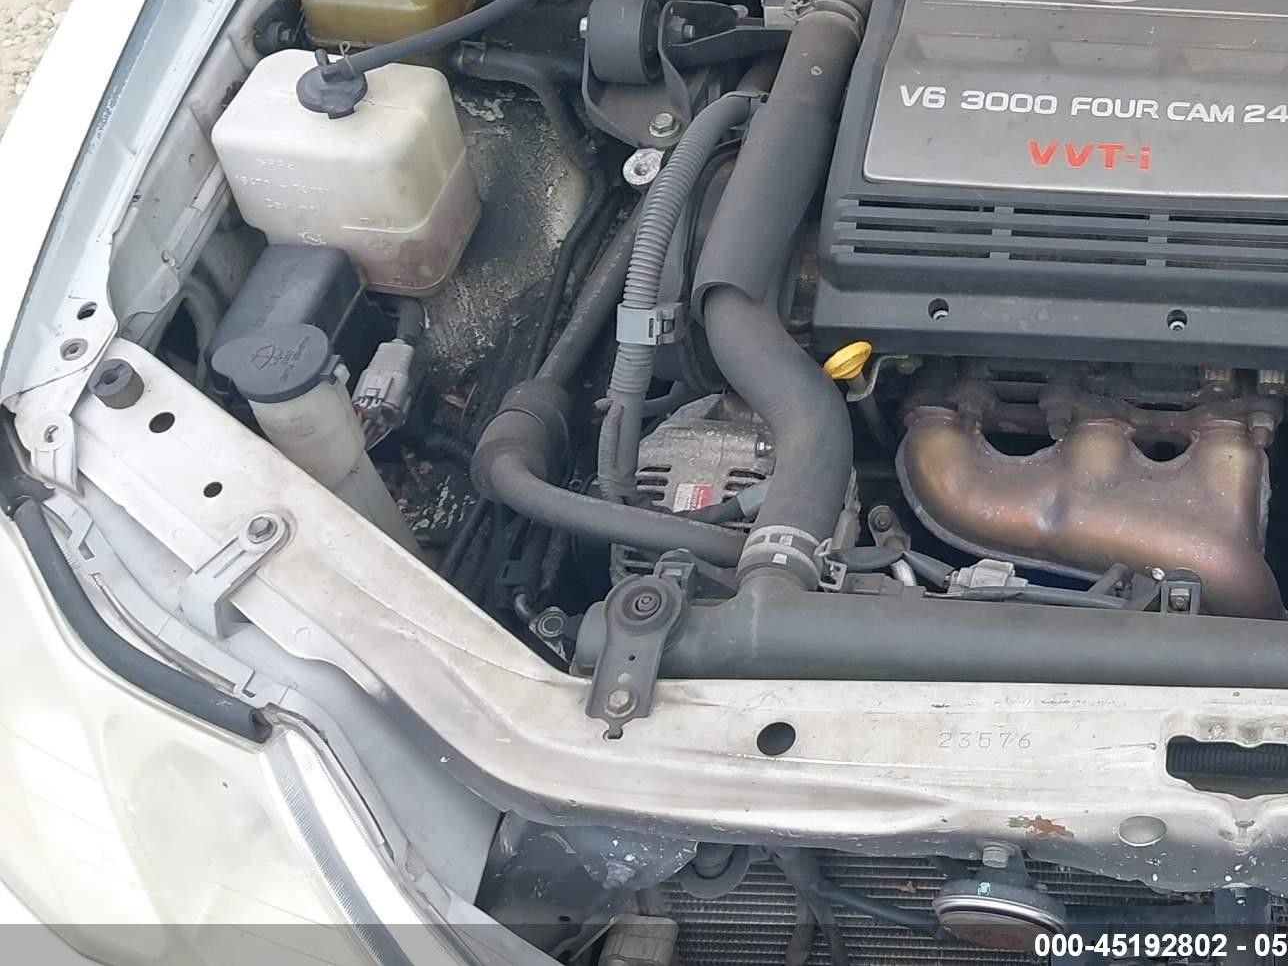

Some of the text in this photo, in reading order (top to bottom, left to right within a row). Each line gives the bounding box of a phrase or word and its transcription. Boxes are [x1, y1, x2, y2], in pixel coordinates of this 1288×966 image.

[900, 85, 1288, 123] V6 3000 FOUR CAM 24
[1027, 139, 1152, 170] VVT-i
[938, 731, 1031, 749] 23576
